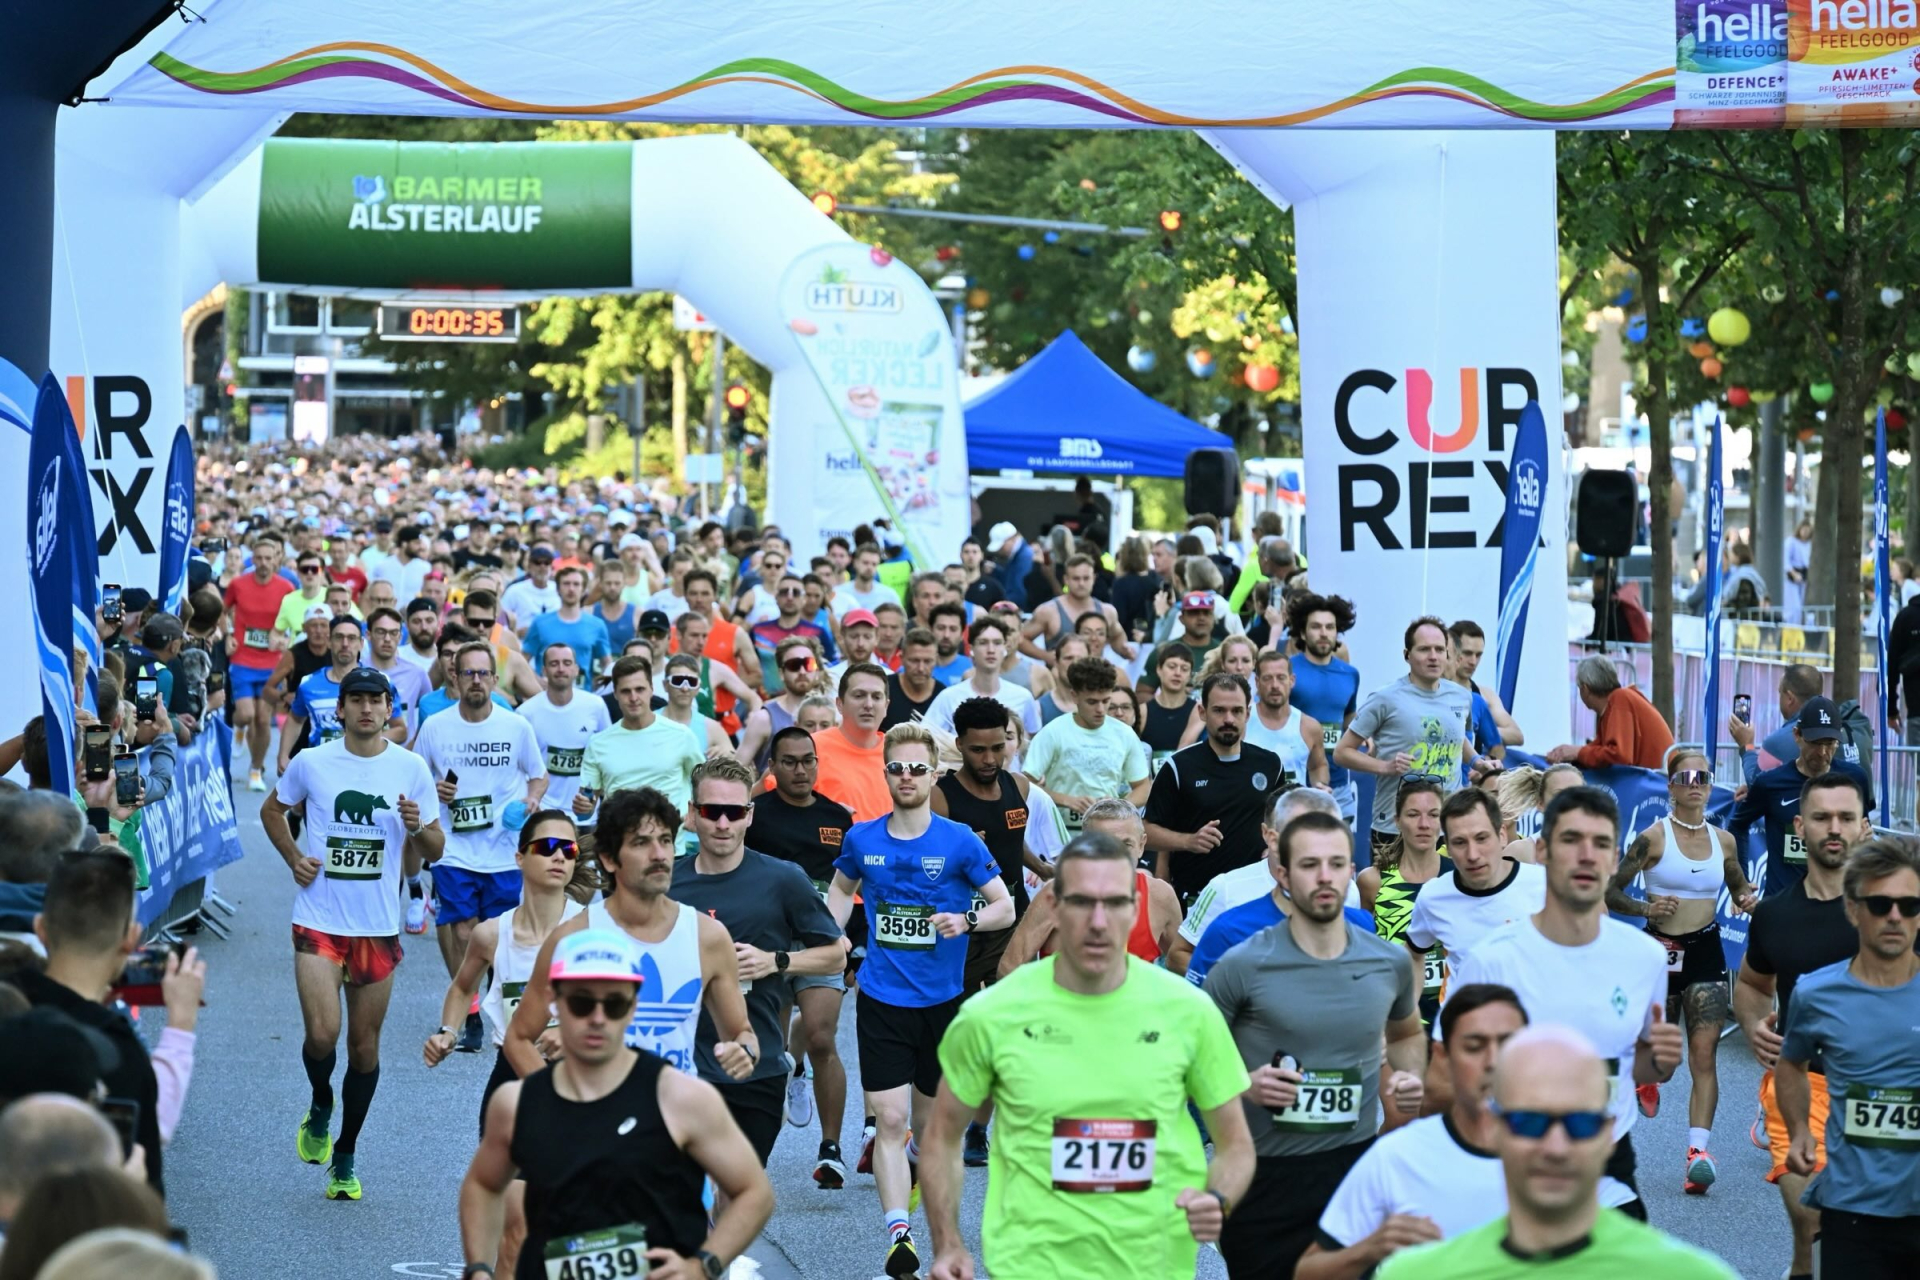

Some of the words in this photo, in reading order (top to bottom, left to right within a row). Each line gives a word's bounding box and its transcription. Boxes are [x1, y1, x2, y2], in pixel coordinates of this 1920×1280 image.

[1697, 3, 1789, 42] hella
[1811, 0, 1917, 31] hella
[1820, 31, 1910, 48] FEELGOOD
[1832, 66, 1898, 81] AWAKE+
[1707, 76, 1785, 90] DEFENCE+
[1818, 82, 1910, 93] PFIRSICH-LIMETTEN-
[1688, 90, 1733, 100] SCHWARZE
[1708, 98, 1786, 107] MINZ-GESCHMACK
[1835, 90, 1892, 100] GESCHMACK
[393, 175, 543, 201] BARMER
[348, 202, 543, 234] ALSTERLAUF
[410, 308, 504, 336] 0:00:35
[1819, 708, 1832, 725] LA
[456, 742, 512, 753] UNDER
[442, 756, 511, 768] ARMOUR
[550, 754, 583, 769] 4782
[452, 805, 488, 824] 2011
[331, 848, 379, 868] 5874
[863, 854, 886, 866] NICK
[880, 915, 930, 938] 3598
[1854, 1101, 1920, 1131] 5749
[1063, 1141, 1147, 1171] 2176
[557, 1247, 639, 1280] 4639
